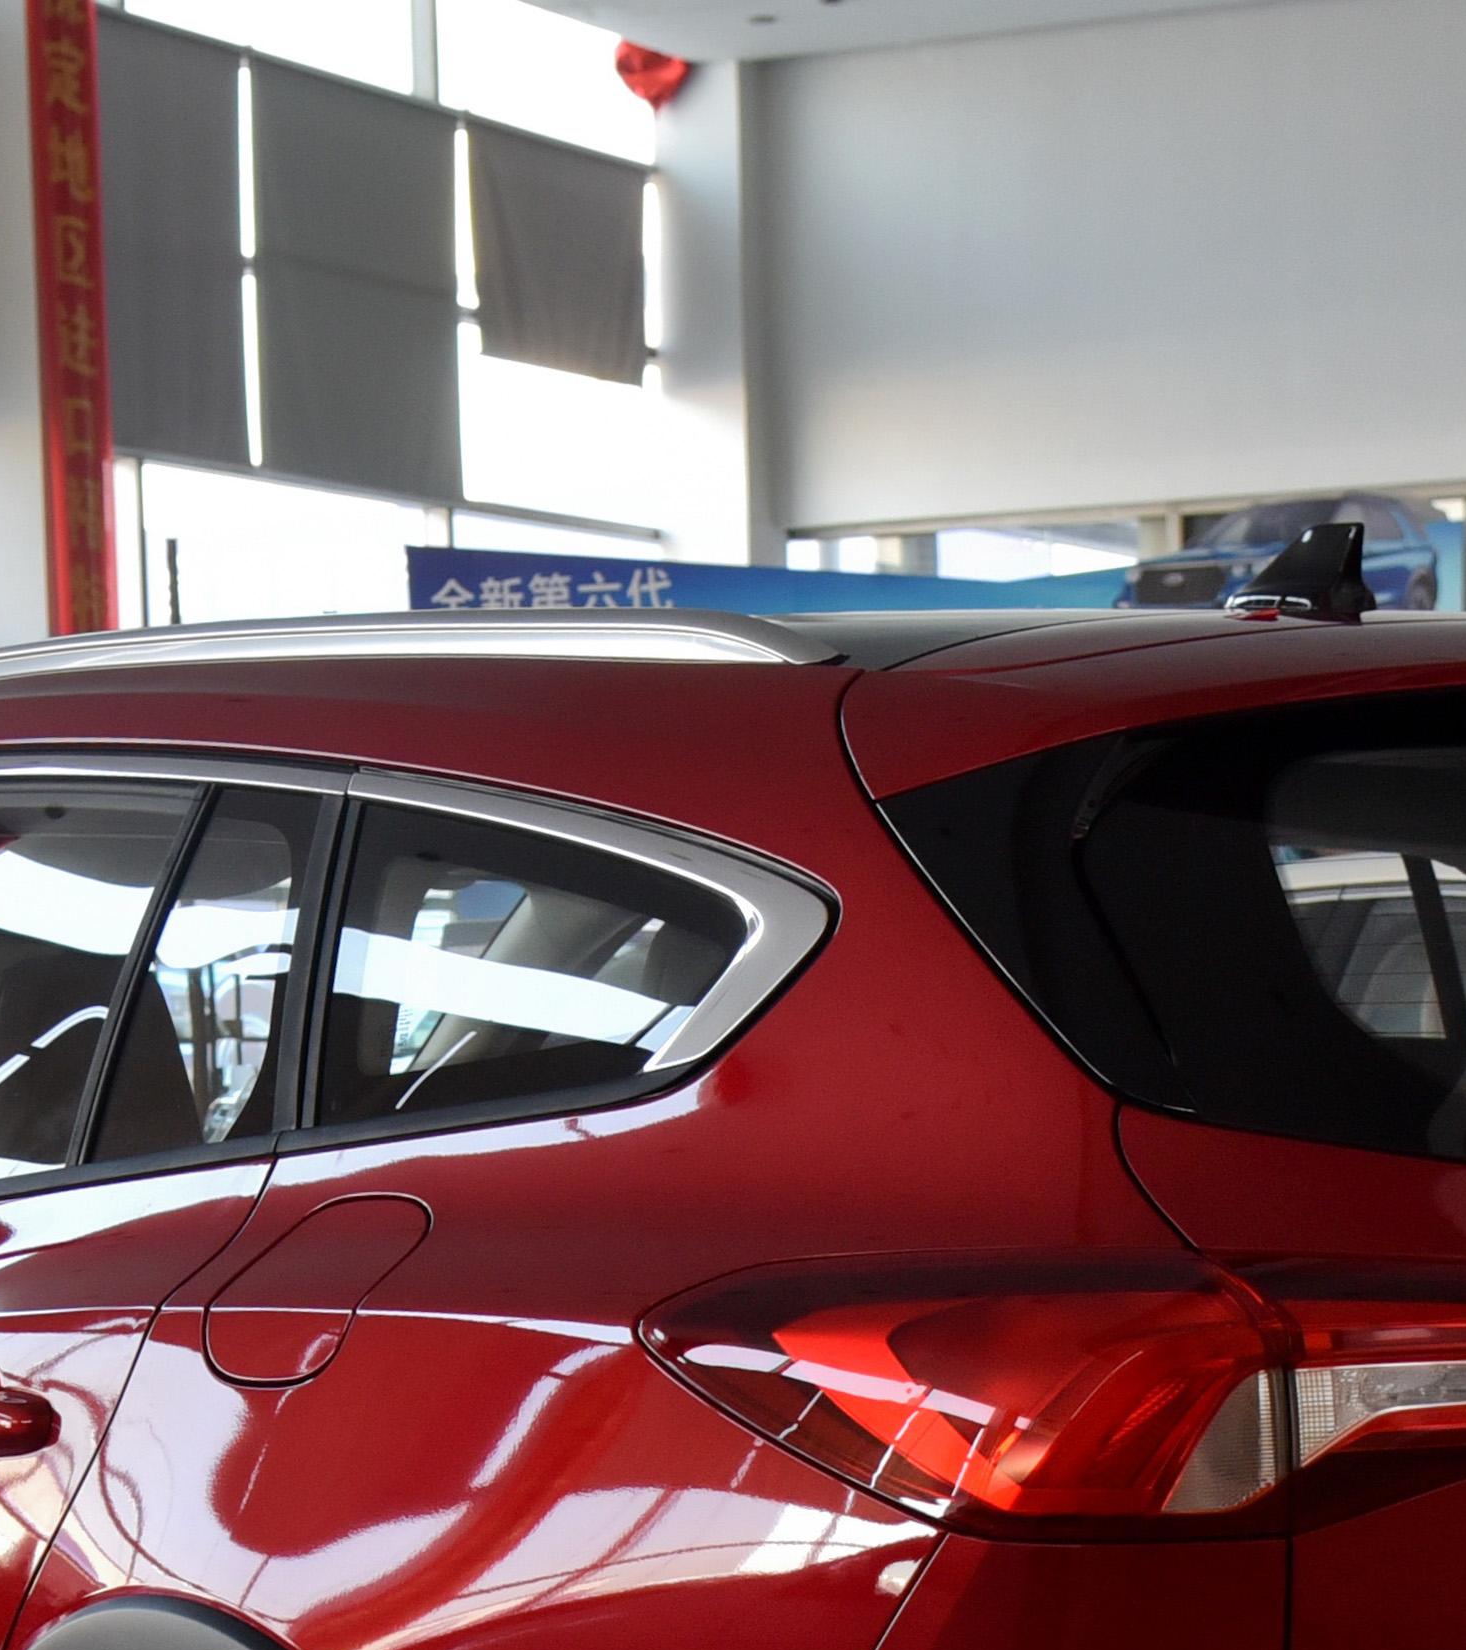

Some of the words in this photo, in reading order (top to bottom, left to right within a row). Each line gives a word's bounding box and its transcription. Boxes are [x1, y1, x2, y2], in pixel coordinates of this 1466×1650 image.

[431, 567, 675, 610] 全新第六代
